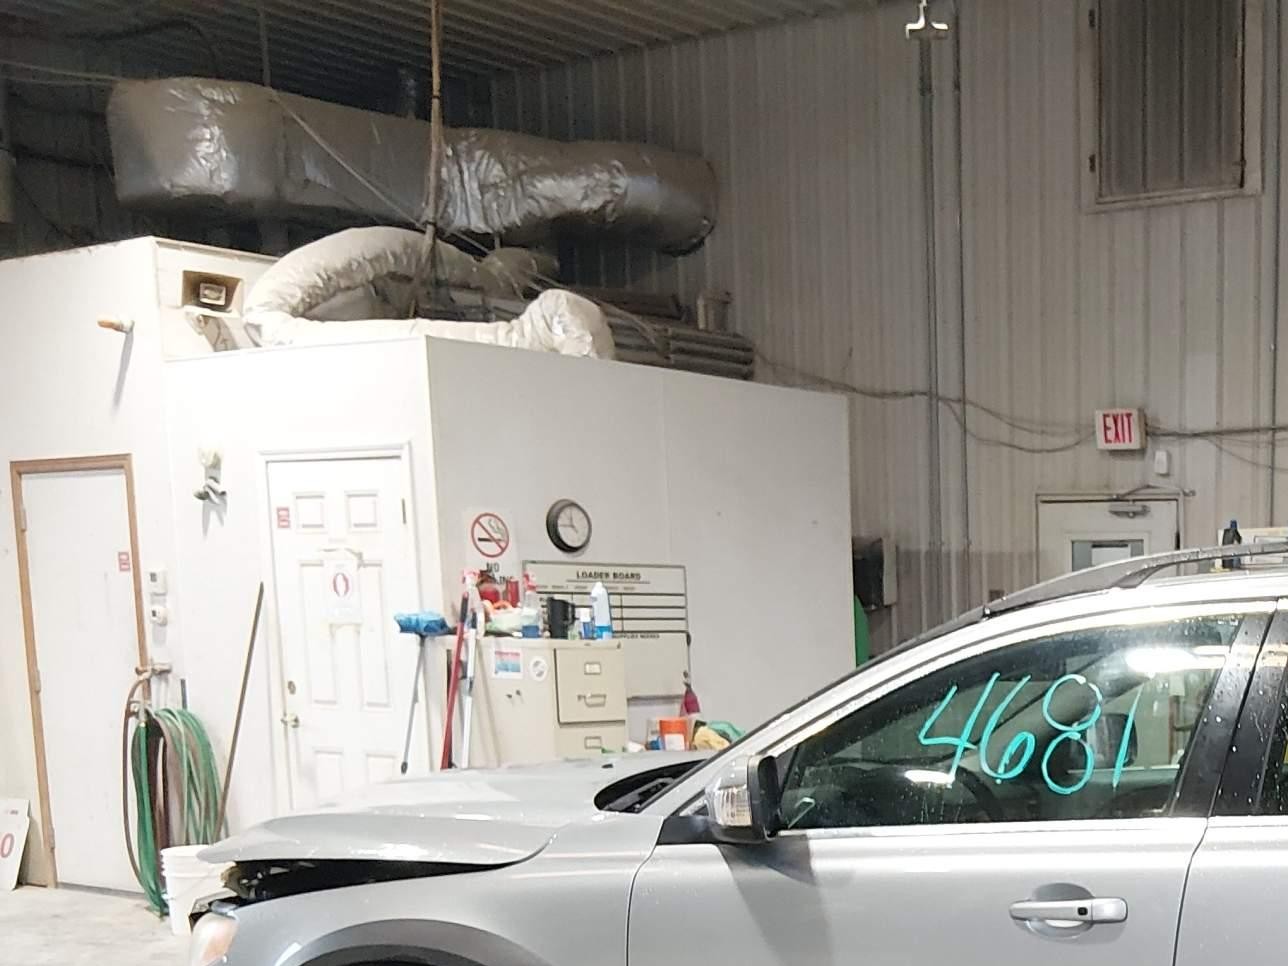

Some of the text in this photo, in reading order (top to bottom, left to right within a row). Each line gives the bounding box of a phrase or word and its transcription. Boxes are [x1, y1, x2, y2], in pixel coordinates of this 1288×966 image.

[1103, 413, 1132, 444] EXIT
[576, 571, 641, 581] LOADER BOARD
[918, 672, 1145, 795] 4681
